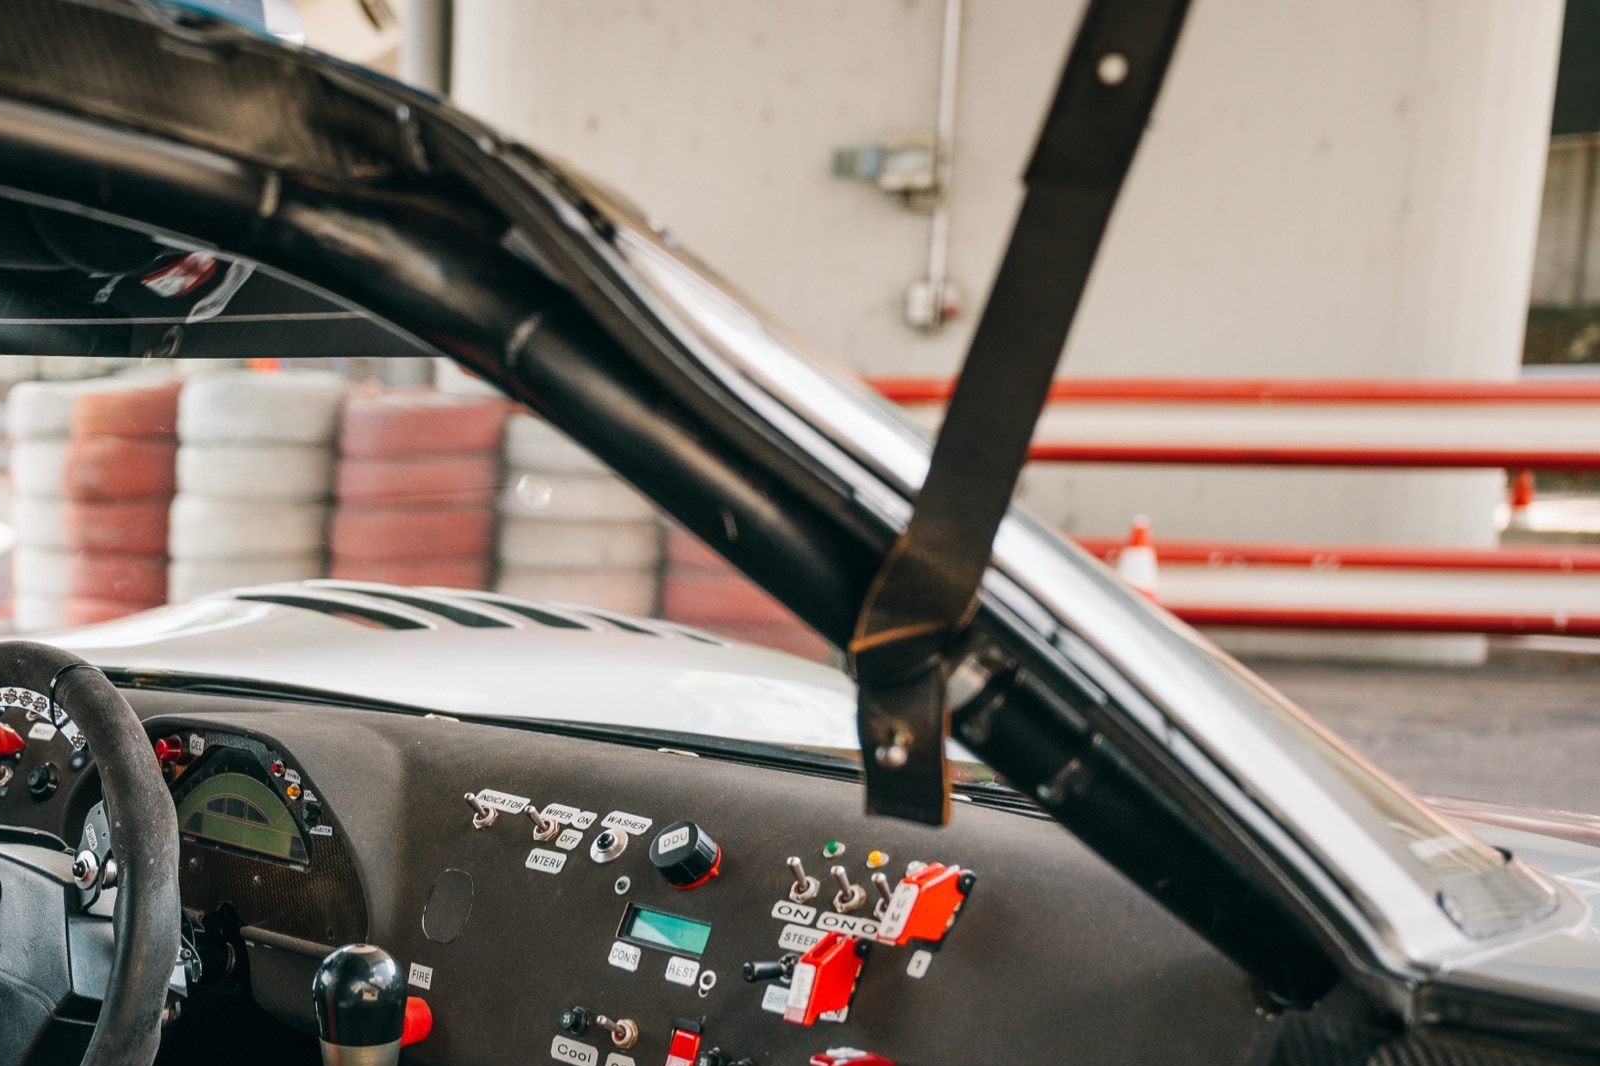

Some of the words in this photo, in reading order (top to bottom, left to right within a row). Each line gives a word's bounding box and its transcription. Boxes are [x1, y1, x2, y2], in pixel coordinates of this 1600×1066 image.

[191, 740, 202, 751] OEL
[480, 793, 524, 811] INDICATOR
[546, 808, 573, 821] WIPER
[577, 815, 591, 826] ON
[607, 815, 647, 831] WASHER
[86, 825, 96, 849] Funk
[560, 834, 578, 845] OFF
[663, 832, 689, 849] DDU
[530, 854, 563, 869] INTERV
[778, 905, 809, 919] ON
[823, 916, 857, 930] ON
[611, 947, 638, 966] CONS
[668, 963, 695, 979] REST
[412, 969, 430, 984] FIRE
[562, 1013, 571, 1025] 35
[557, 1043, 592, 1064] Cool
